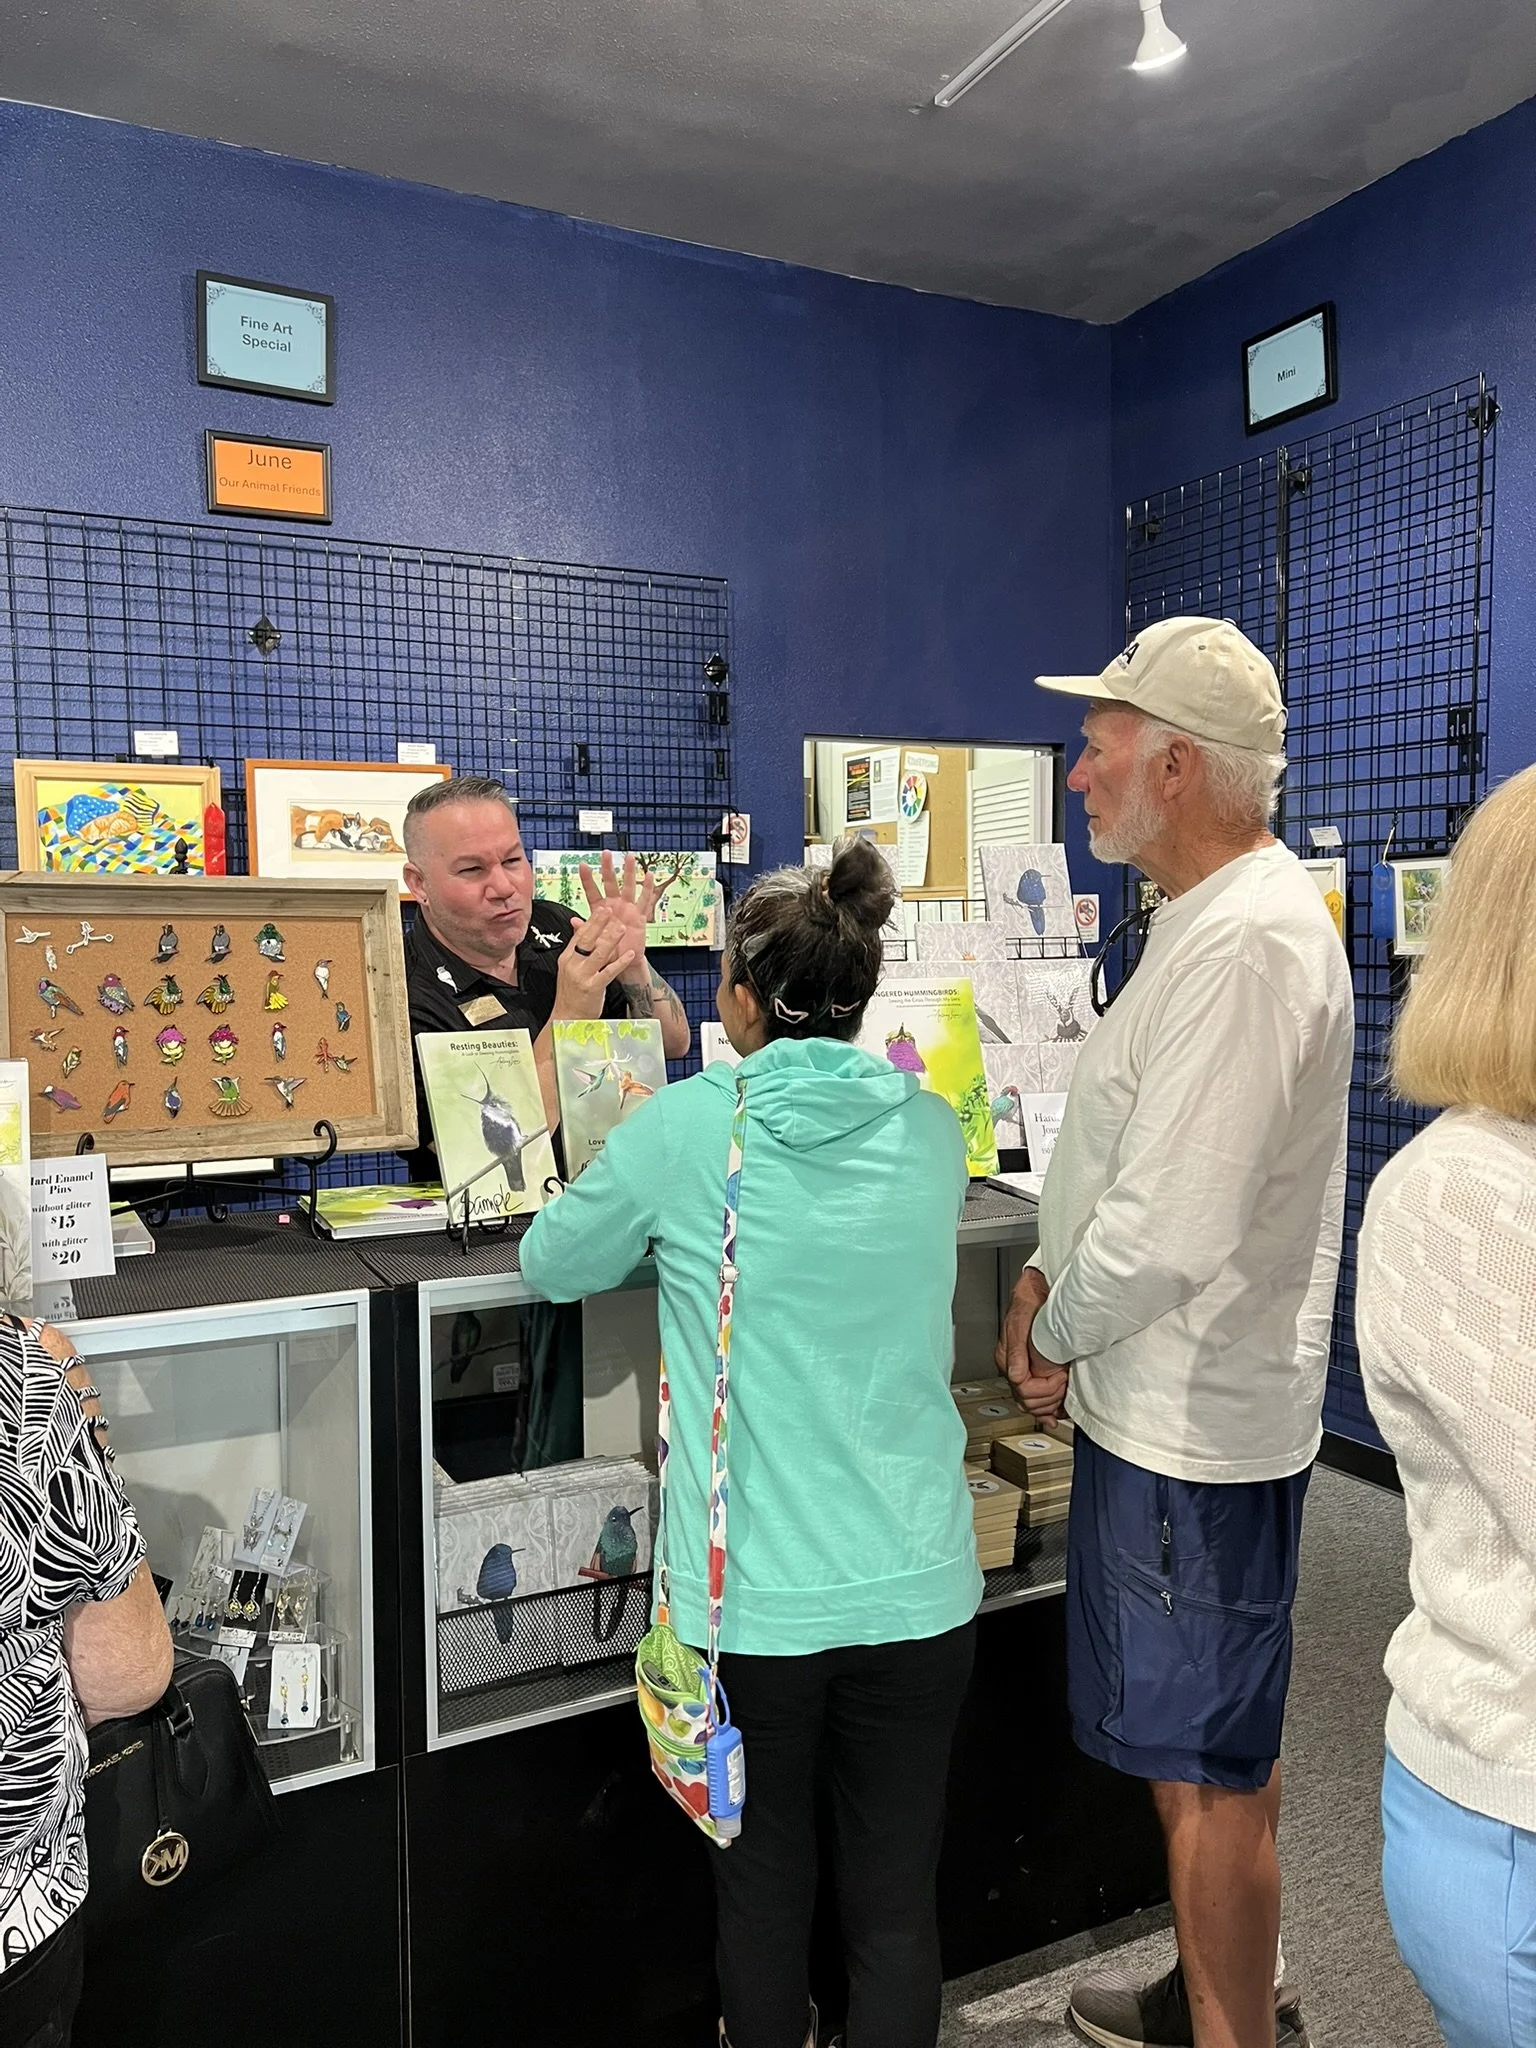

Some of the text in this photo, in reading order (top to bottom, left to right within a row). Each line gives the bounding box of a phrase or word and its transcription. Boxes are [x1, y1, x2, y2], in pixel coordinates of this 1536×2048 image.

[240, 315, 293, 336] Fine Art
[242, 333, 291, 353] Special
[1277, 365, 1296, 382] Mini
[247, 449, 293, 470] June
[218, 476, 321, 497] Our Animal Friends
[450, 1040, 519, 1052] Resting Beauties:
[56, 1171, 93, 1184] Enamel
[50, 1185, 72, 1195] Pins
[32, 1201, 91, 1213] without glitter
[50, 1214, 76, 1229] $15
[42, 1237, 88, 1248] with glitter
[51, 1249, 81, 1265] $20
